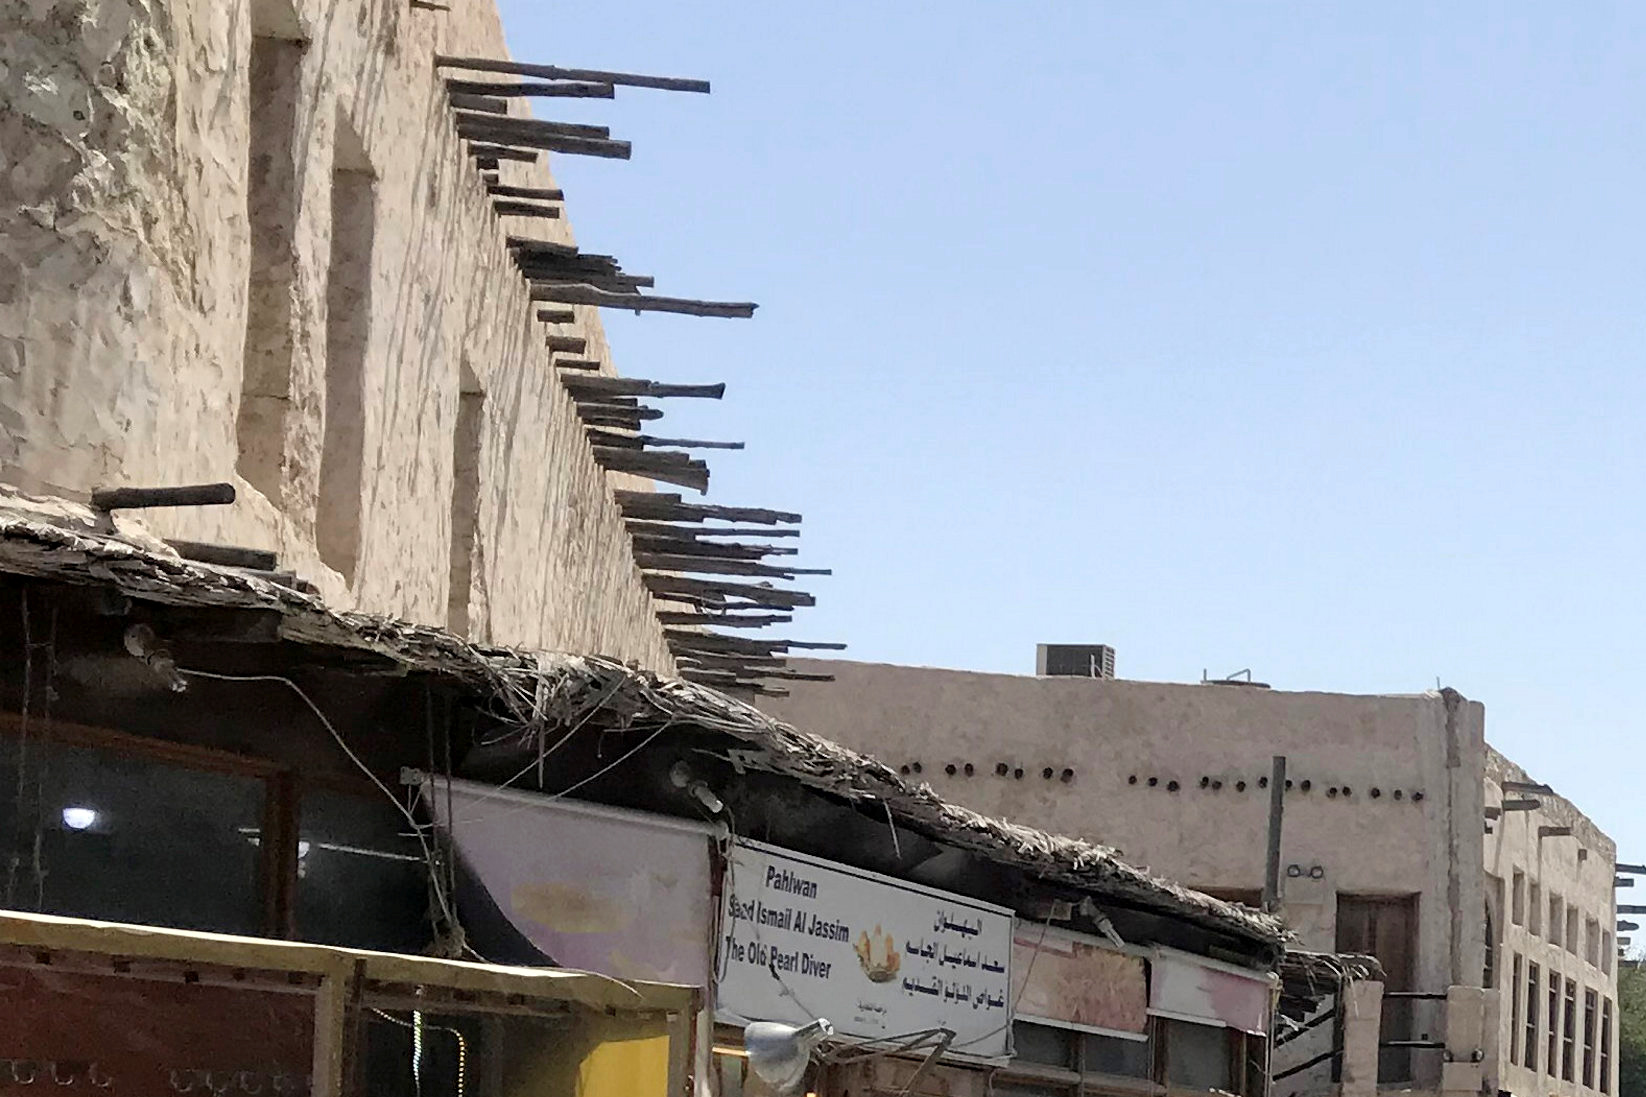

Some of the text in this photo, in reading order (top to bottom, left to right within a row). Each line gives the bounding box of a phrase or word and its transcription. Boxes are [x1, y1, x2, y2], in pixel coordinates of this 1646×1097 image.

[765, 865, 818, 899] Pahlwan
[757, 901, 793, 930] Ismail
[793, 911, 807, 933] Al
[808, 914, 850, 942] Jassim
[726, 936, 832, 979] The Old Pearl Diver
